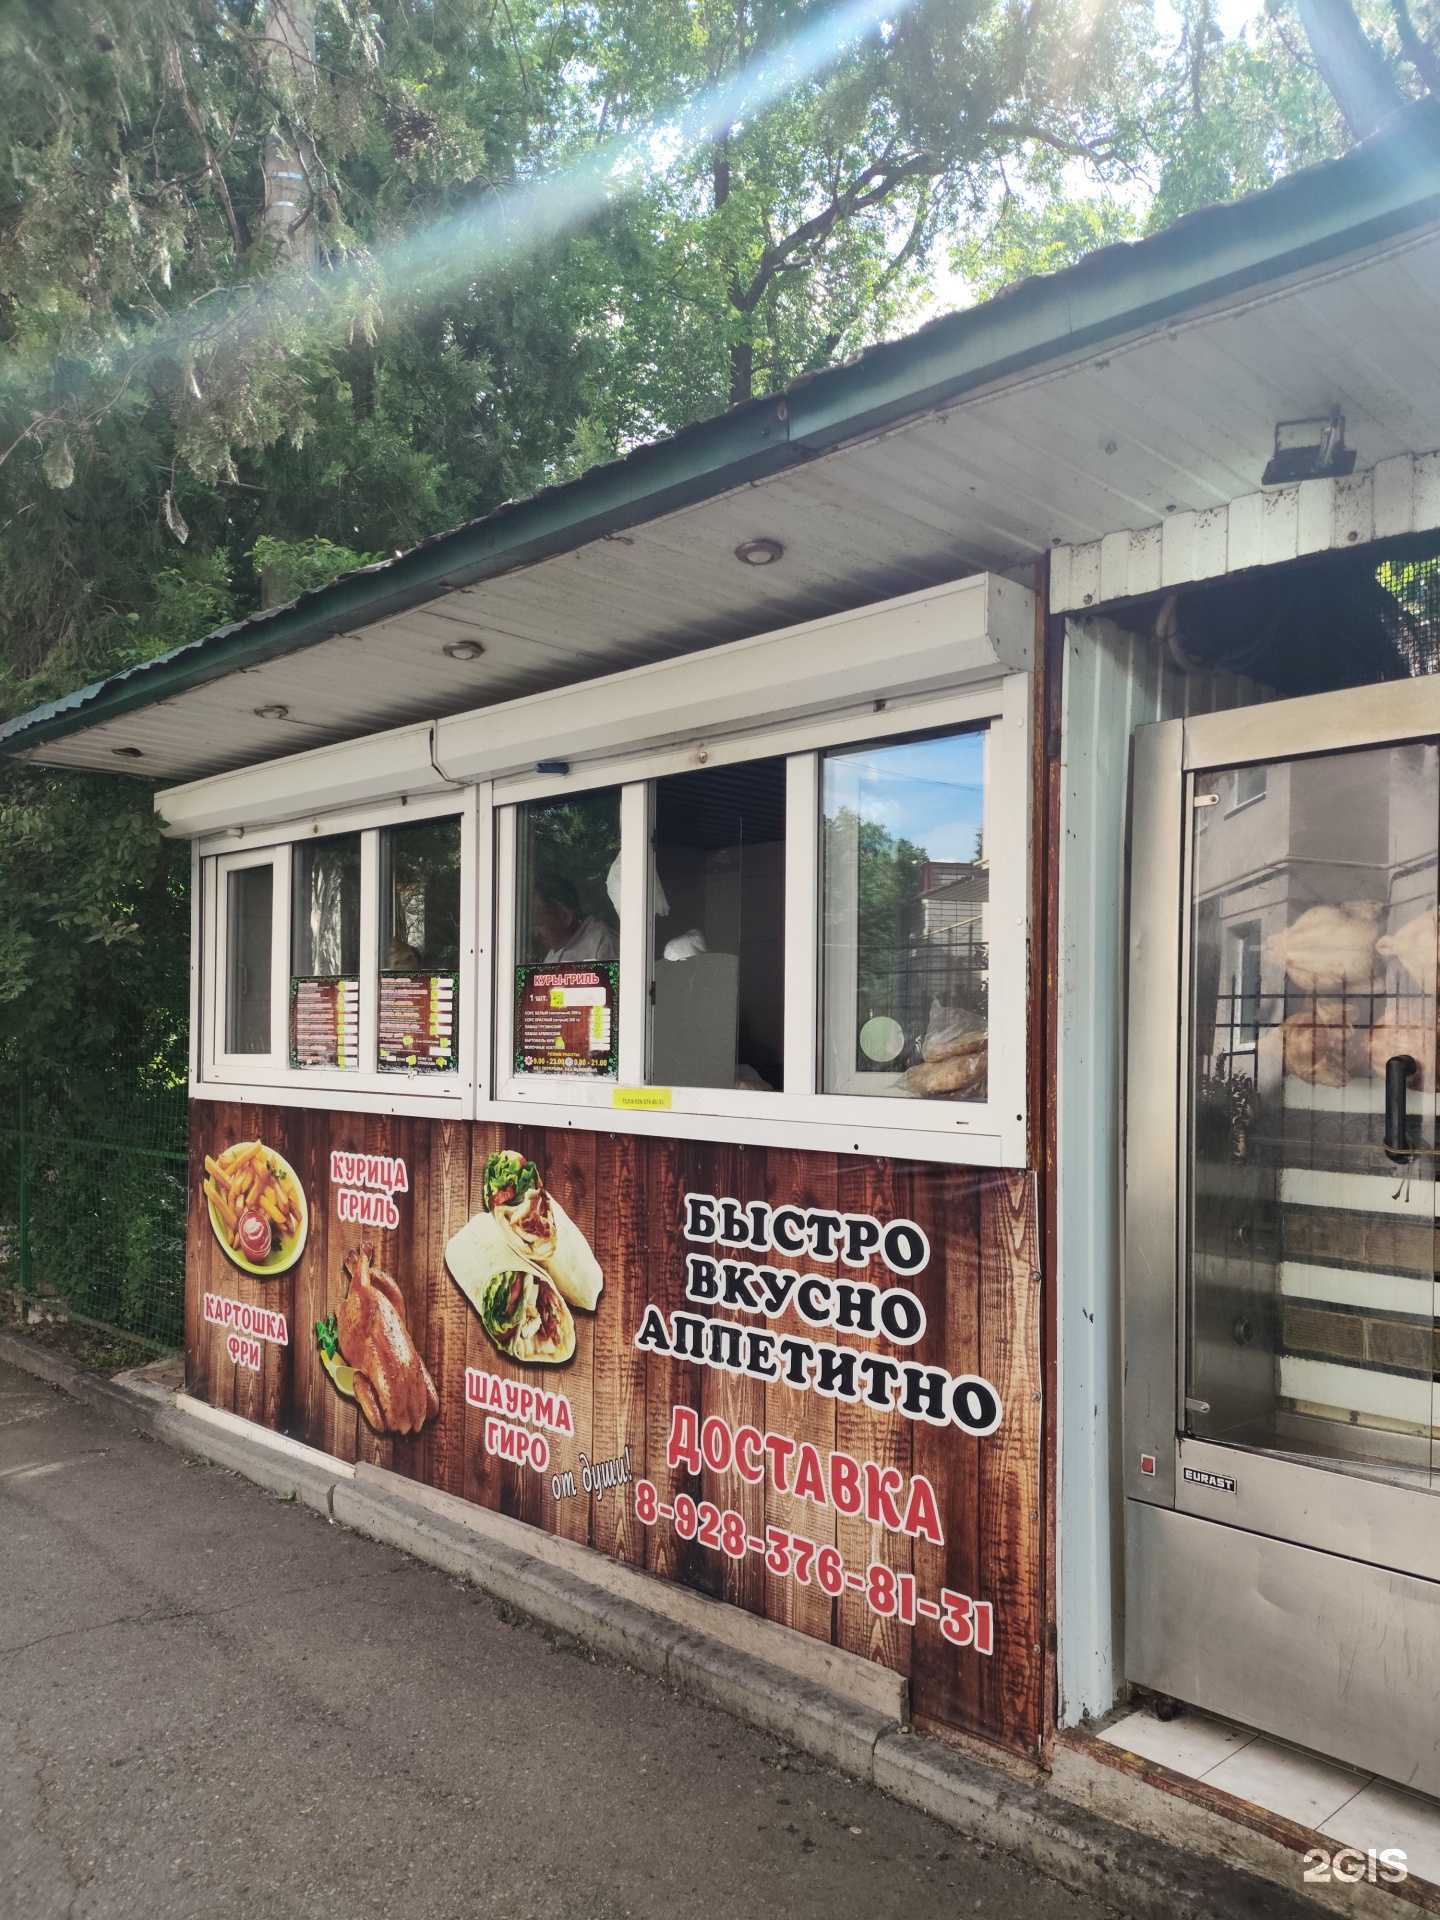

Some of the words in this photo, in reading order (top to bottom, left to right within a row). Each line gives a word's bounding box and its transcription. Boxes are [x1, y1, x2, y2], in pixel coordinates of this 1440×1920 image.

[534, 973, 599, 986] КУРЫ-ГРИЛЬ
[330, 1150, 408, 1192] КУРИЦА
[337, 1188, 399, 1229] ГРИЛЬ
[684, 1192, 930, 1275] БЫСТРО
[204, 1293, 288, 1345] КАРТОШКА
[685, 1254, 926, 1345] ВКУСНО
[228, 1334, 260, 1370] ФРИ
[635, 1304, 1001, 1436] АППЕТИТНО
[465, 1367, 574, 1437] ШАУРМА
[485, 1416, 549, 1472] ГИРО
[552, 1470, 577, 1500] от
[579, 1445, 632, 1501] души!
[667, 1405, 944, 1546] ДОСТАВКА
[1184, 1469, 1234, 1490] EURAST
[635, 1480, 993, 1655] 8-928-376-81-31
